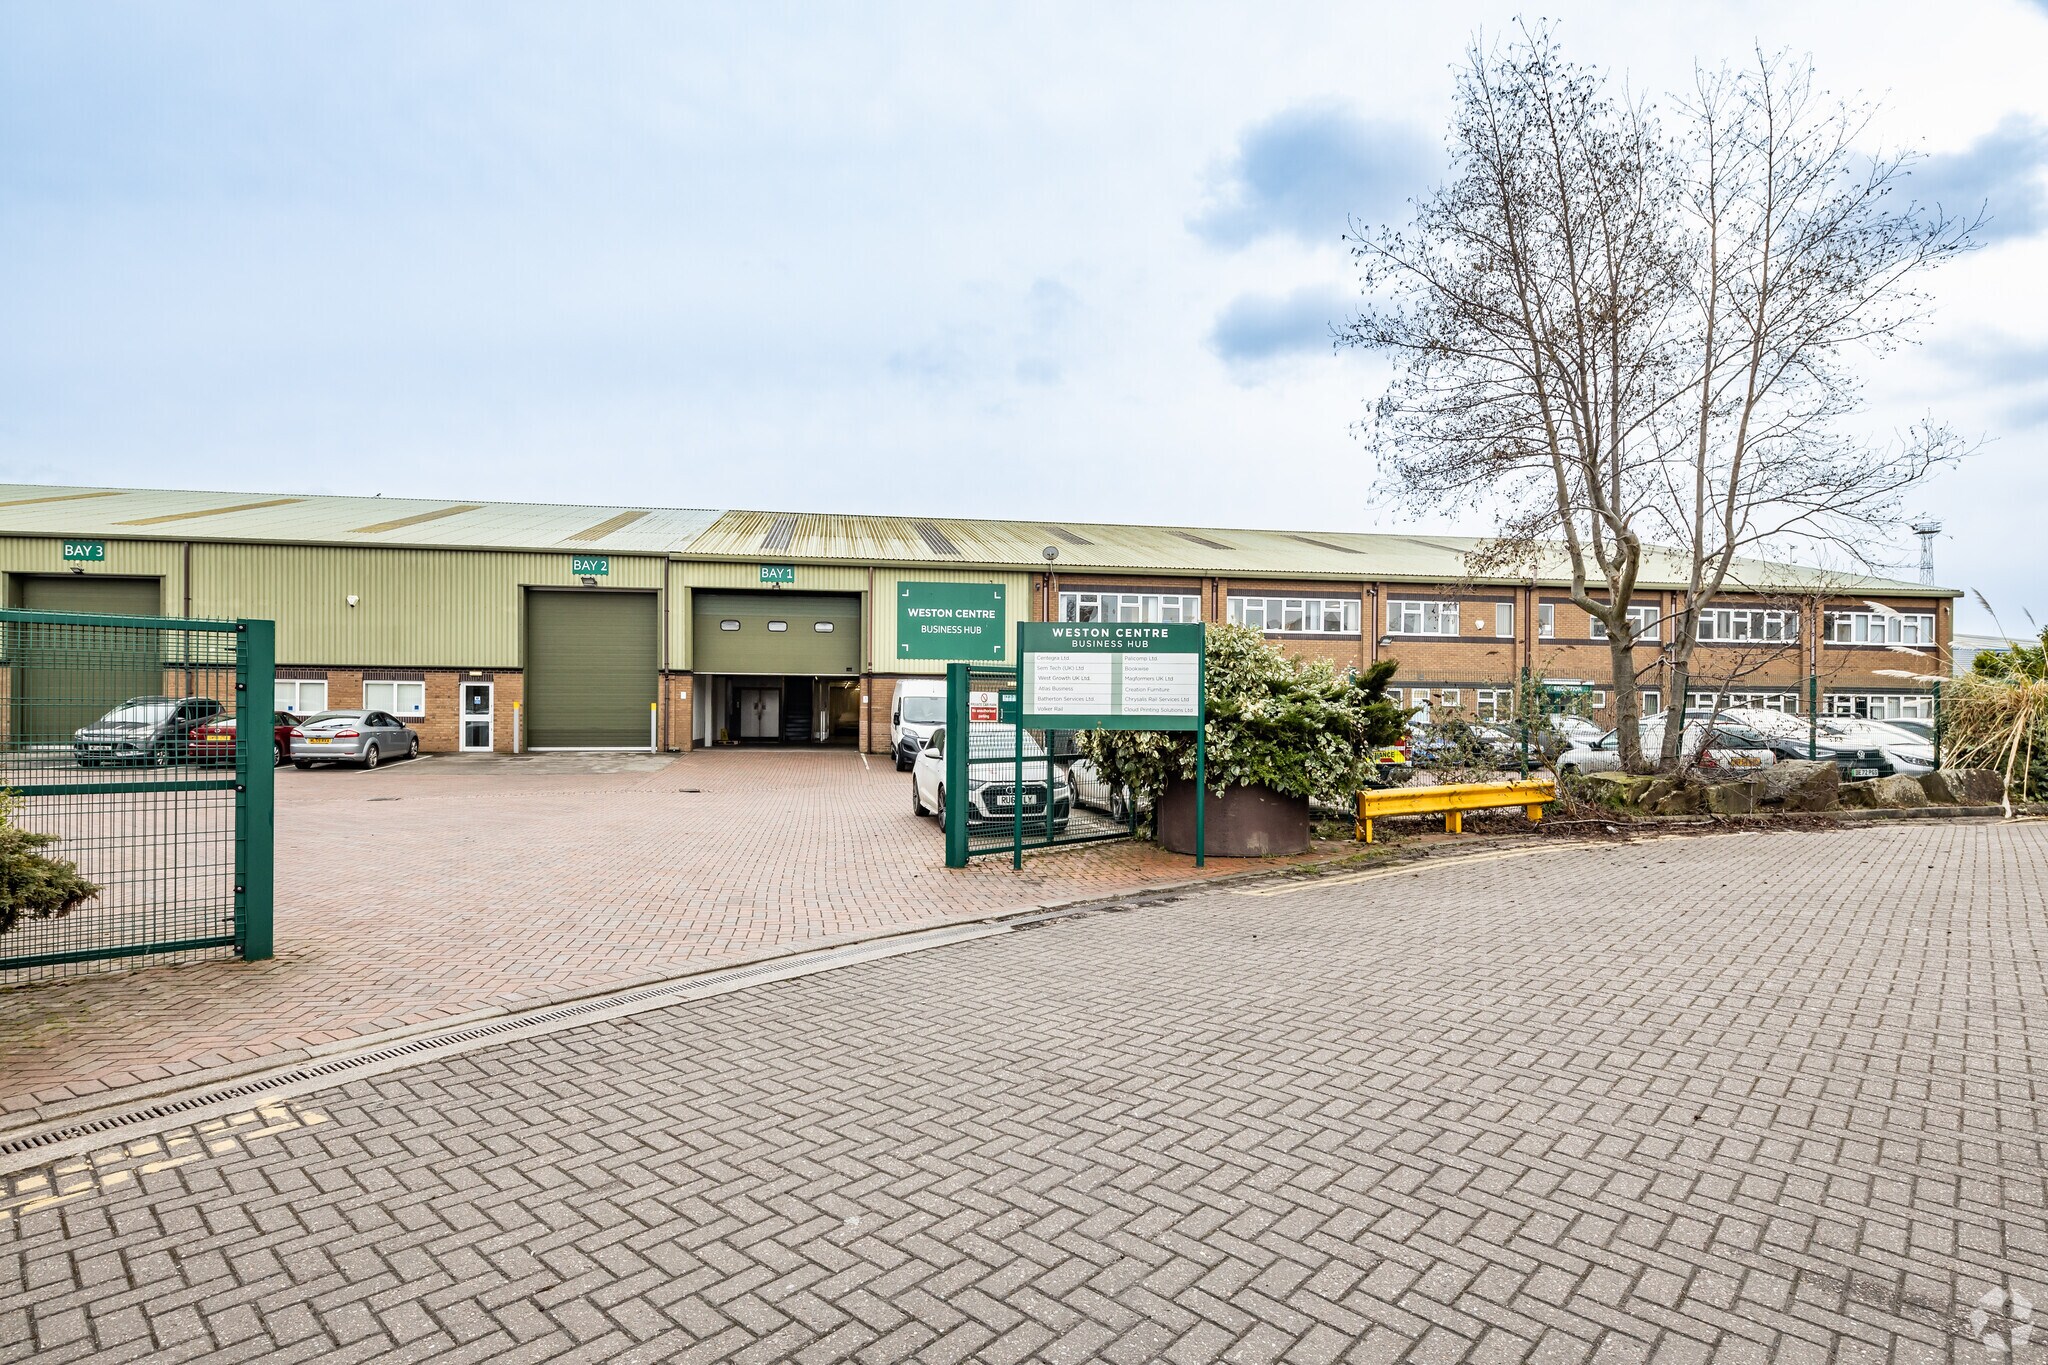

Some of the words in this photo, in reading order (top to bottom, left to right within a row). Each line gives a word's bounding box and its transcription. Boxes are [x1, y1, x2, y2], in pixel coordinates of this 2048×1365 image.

[65, 544, 92, 556] BAY
[96, 546, 103, 556] 3
[574, 560, 598, 570] BAY
[600, 560, 608, 571] 2
[762, 567, 784, 578] BAY
[787, 569, 792, 578] 1
[908, 608, 952, 618] WESTON
[955, 609, 996, 618] CENTRE
[921, 625, 962, 634] BUSINESS
[964, 626, 982, 634] HUB
[1052, 628, 1110, 638] WESTON
[1116, 628, 1169, 638] CENTRE
[1072, 640, 1123, 648] BUSINESS
[1127, 640, 1149, 648] HUB
